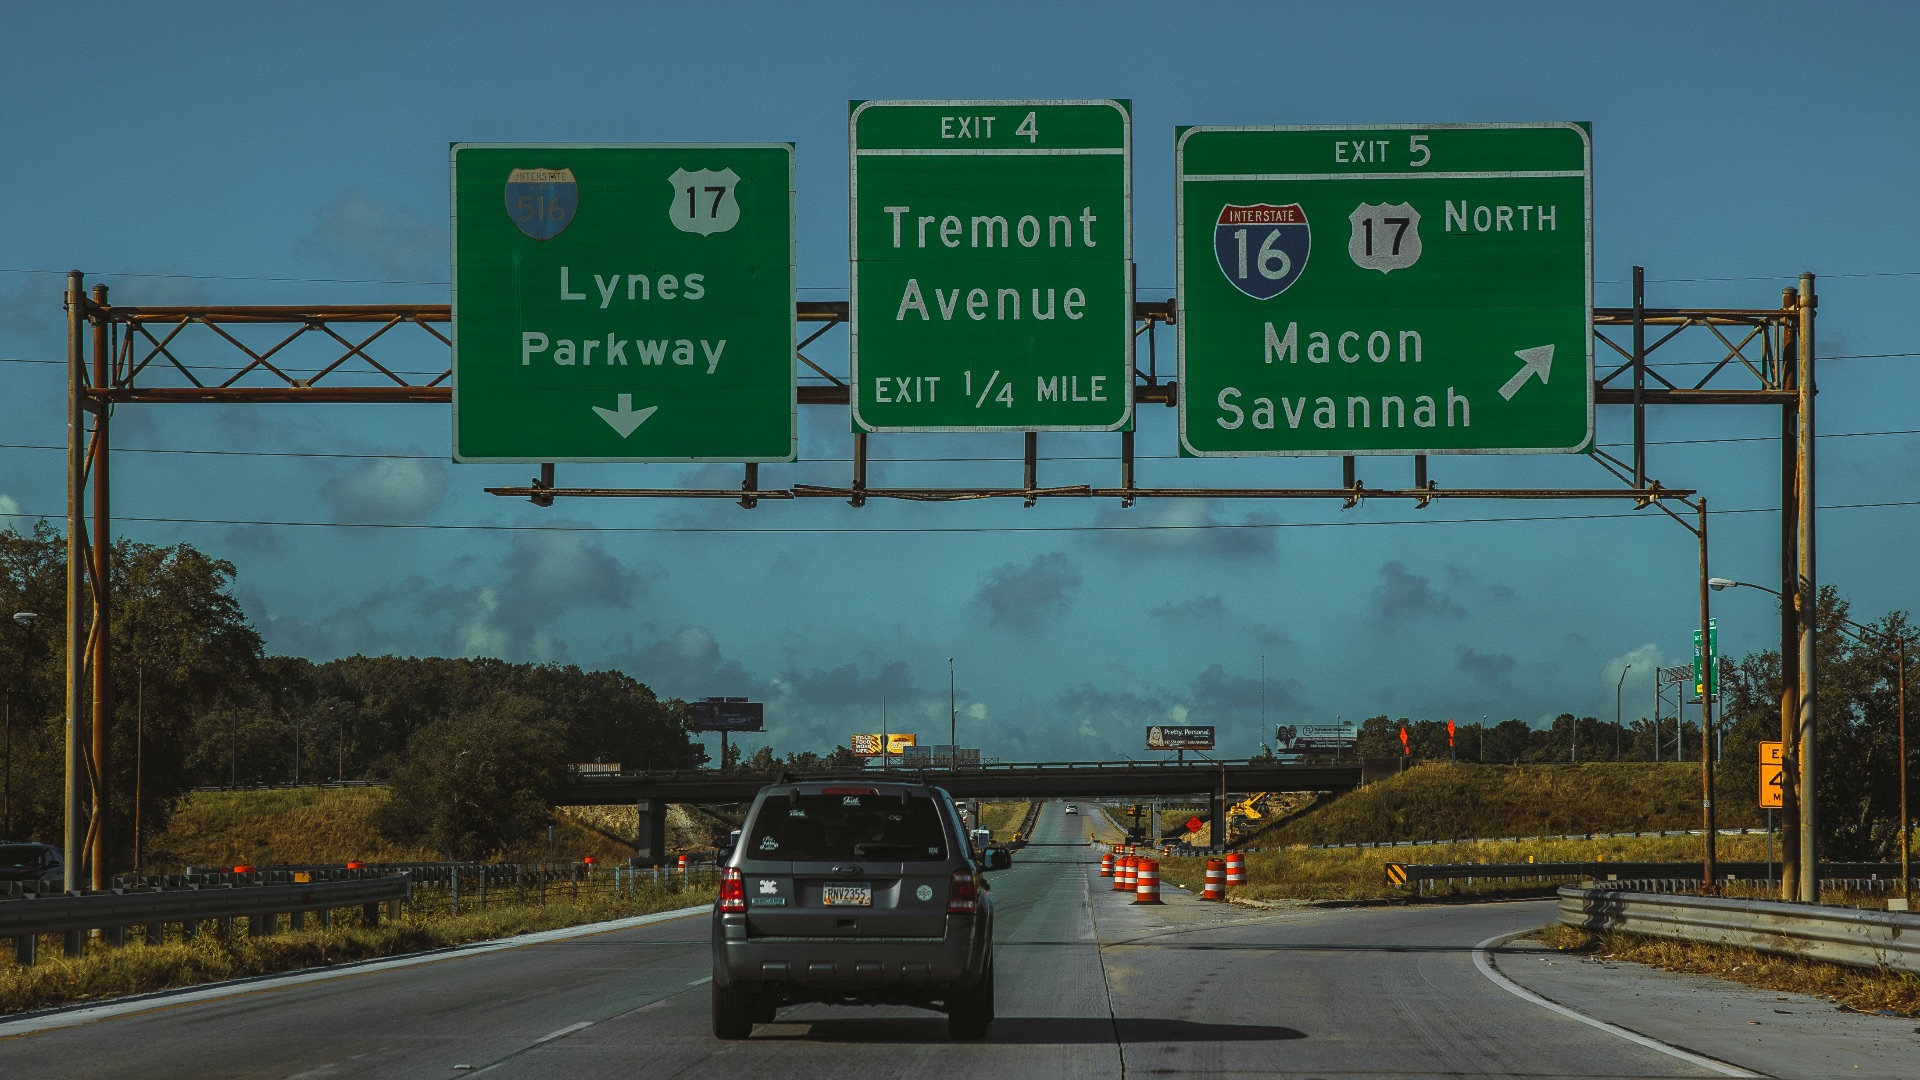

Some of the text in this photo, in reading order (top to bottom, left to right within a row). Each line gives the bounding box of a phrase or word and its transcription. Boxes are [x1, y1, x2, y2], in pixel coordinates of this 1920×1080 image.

[942, 111, 1039, 144] EXIT 4
[1335, 135, 1431, 167] EXIT 5
[514, 171, 567, 181] INTERSTATE
[517, 195, 565, 222] 516
[687, 187, 726, 219] 17
[1229, 209, 1295, 223] INTERSTATE
[1445, 200, 1556, 232] NORTH
[884, 206, 1097, 248] Tremont
[1362, 217, 1410, 257] 17
[1234, 228, 1291, 281] 16
[560, 267, 705, 309] Lynes
[896, 278, 1086, 321] Avenue
[522, 332, 727, 375] Parkway
[1264, 321, 1422, 364] Macon
[876, 370, 1108, 409] EXIT 1/4 MILE
[1216, 387, 1470, 430] Savannah
[1184, 728, 1211, 736] Personal.
[827, 888, 866, 900] RNV2355
